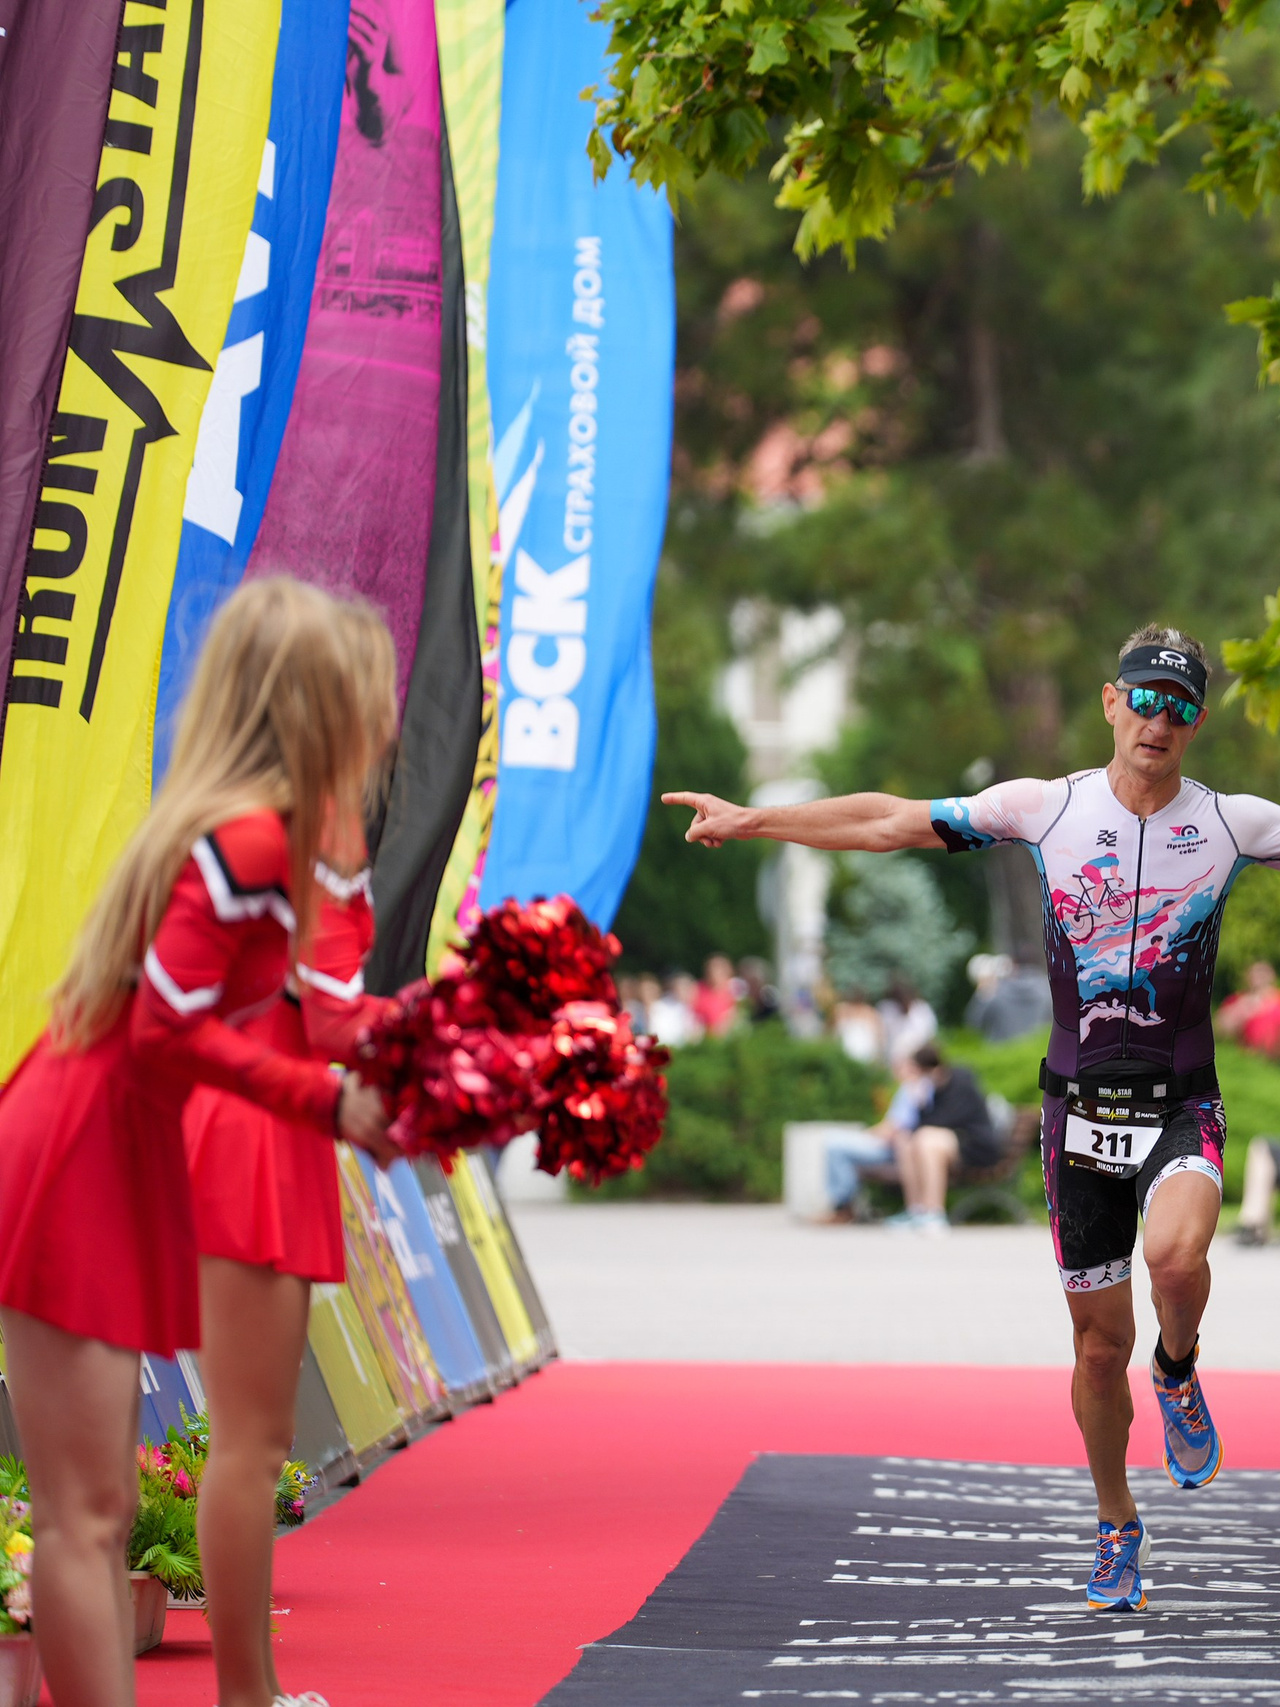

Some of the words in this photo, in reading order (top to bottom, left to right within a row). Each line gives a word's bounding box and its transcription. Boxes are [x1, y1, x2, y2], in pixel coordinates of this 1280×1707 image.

[87, 0, 167, 252] STA
[572, 237, 606, 328] ДОМ
[563, 332, 600, 553] СТРАХОВОЙ
[502, 547, 591, 772] ВСК
[1150, 658, 1192, 675] OAKLEY
[1117, 1088, 1132, 1096] STAR
[1115, 1107, 1130, 1116] STAR
[1091, 1129, 1132, 1158] 211
[1096, 1161, 1124, 1174] NIKOLAY
